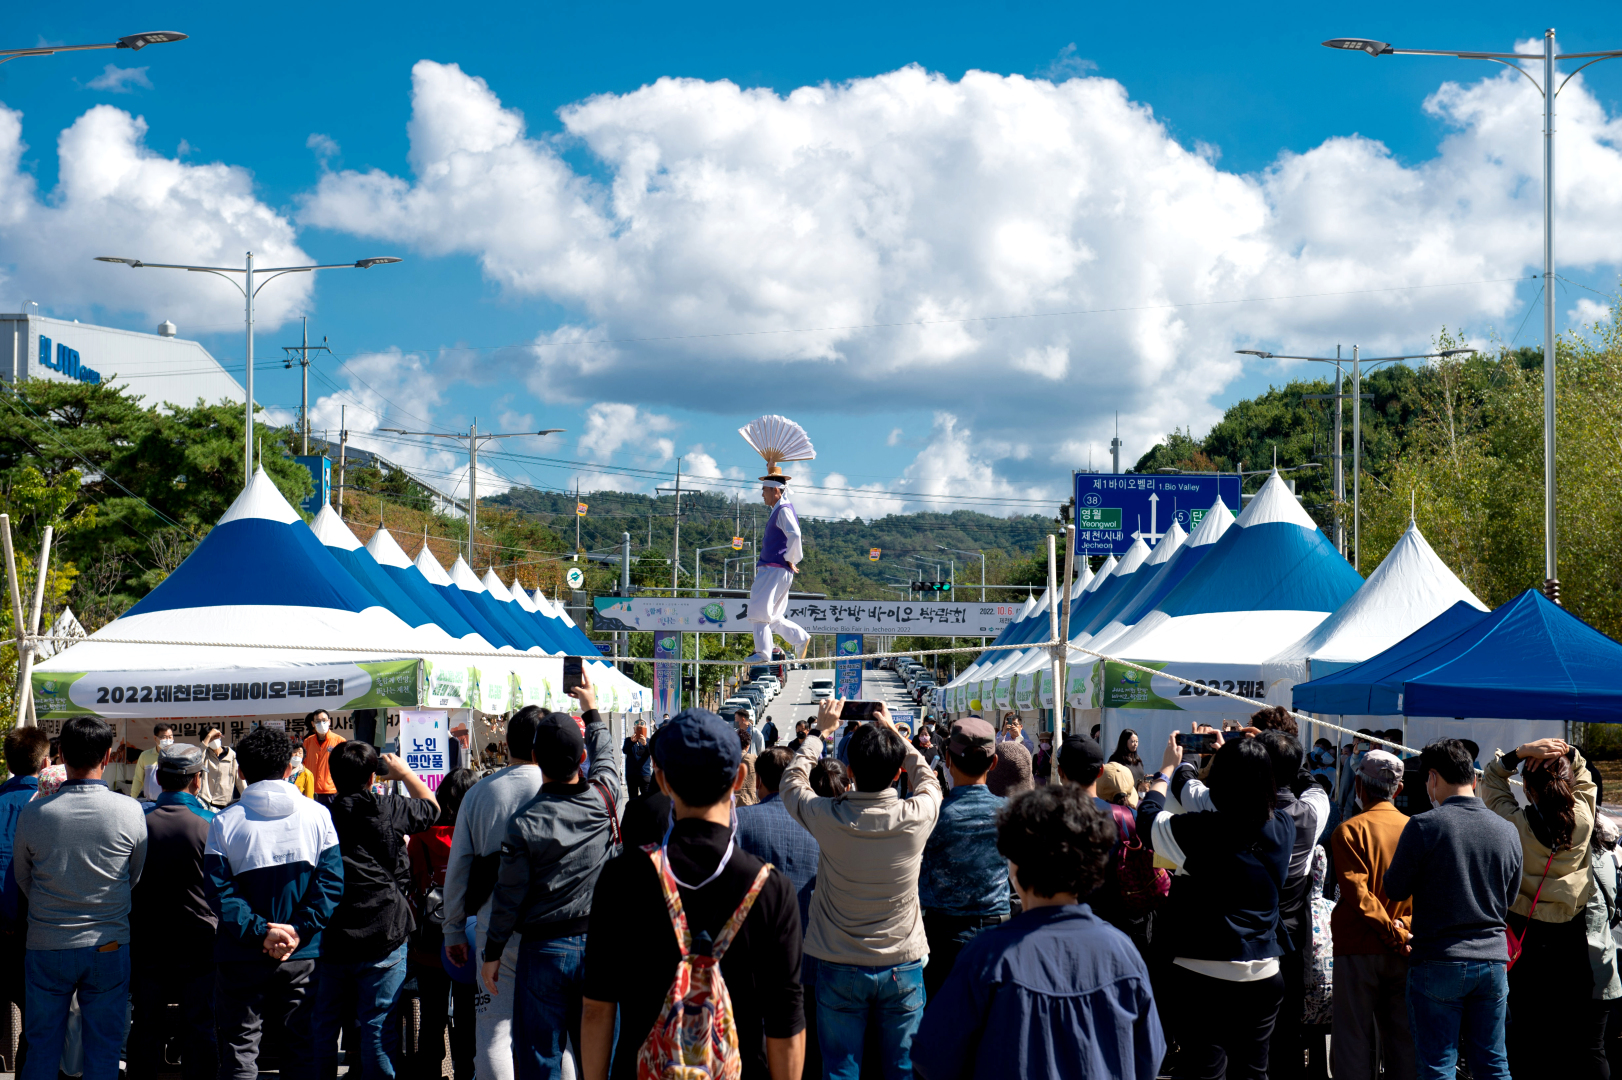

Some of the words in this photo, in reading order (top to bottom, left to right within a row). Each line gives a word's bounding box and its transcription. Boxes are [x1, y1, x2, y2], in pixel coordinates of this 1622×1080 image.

[1178, 483, 1200, 492] Valley
[1086, 496, 1098, 505] 38
[1081, 509, 1102, 520] 영월
[1177, 512, 1184, 521] 5
[1081, 520, 1117, 529] Yeongwol
[1081, 531, 1124, 542] 제천(시내)
[871, 626, 895, 634] Jecheon
[413, 738, 437, 752] 노인
[407, 754, 443, 769] 생산품
